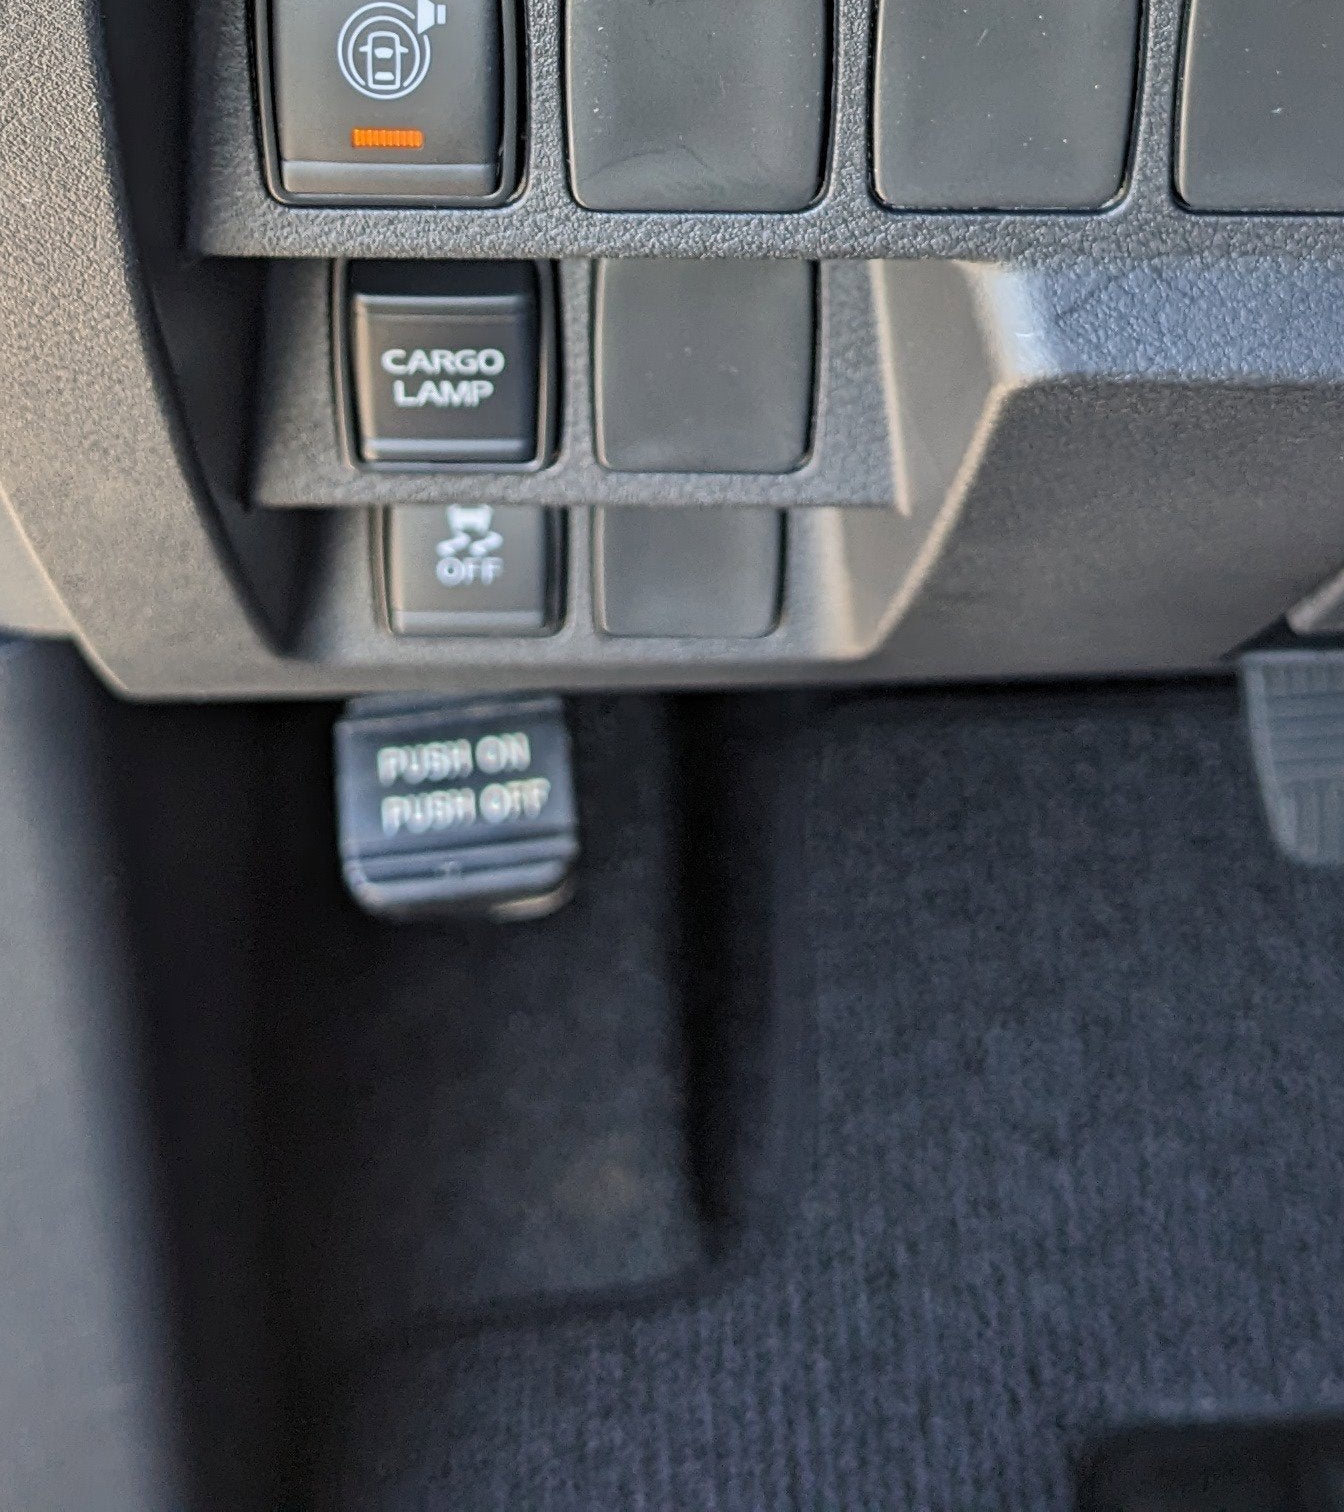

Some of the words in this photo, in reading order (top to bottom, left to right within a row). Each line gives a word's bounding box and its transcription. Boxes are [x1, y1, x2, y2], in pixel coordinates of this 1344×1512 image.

[380, 347, 506, 376] CARGO
[393, 379, 494, 407] LAMP
[435, 556, 502, 585] OFF
[377, 738, 473, 786] PUSH
[475, 731, 531, 774] ON
[381, 787, 476, 837] PUSH
[479, 778, 552, 821] OFF
